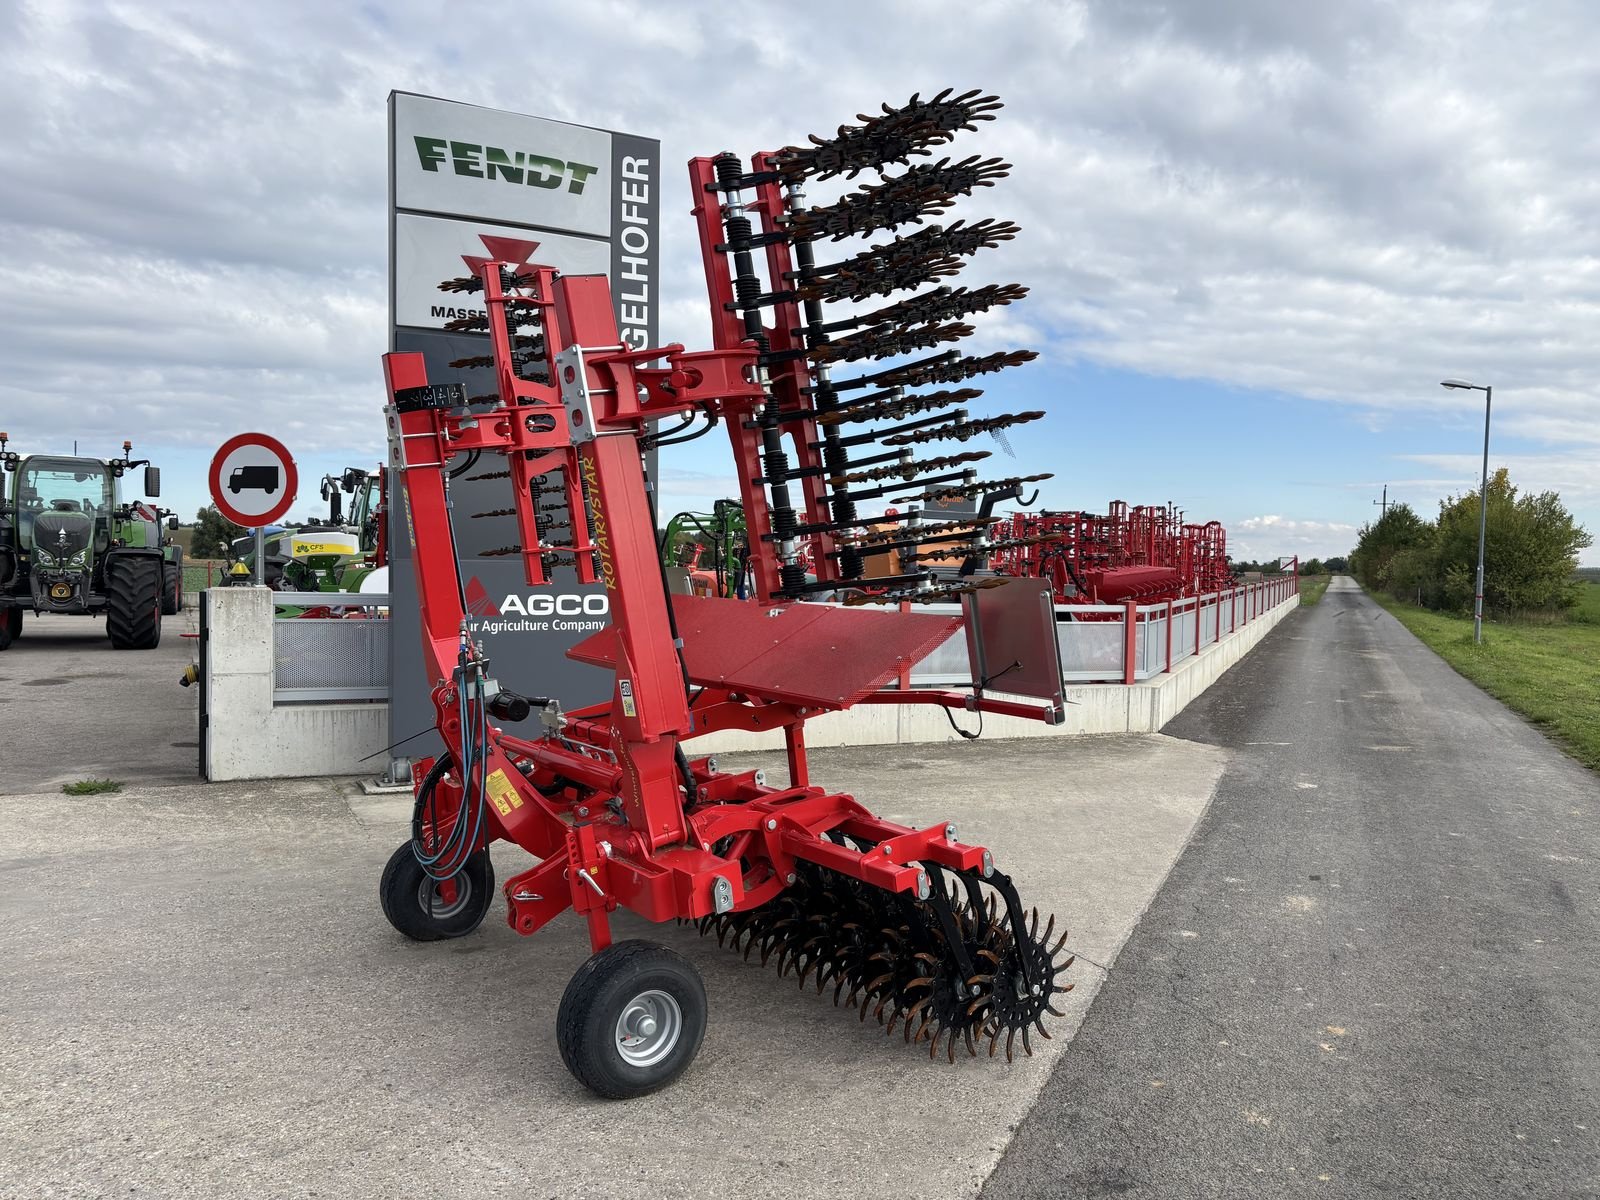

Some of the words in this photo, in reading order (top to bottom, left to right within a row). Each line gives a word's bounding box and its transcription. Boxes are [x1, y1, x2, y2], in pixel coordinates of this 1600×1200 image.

[413, 136, 598, 195] FENDT
[431, 305, 487, 320] MASSE
[583, 457, 616, 590] ROTARYSTAR
[499, 594, 609, 616] AGCO
[482, 620, 549, 635] Agriculture
[552, 620, 605, 632] Company
